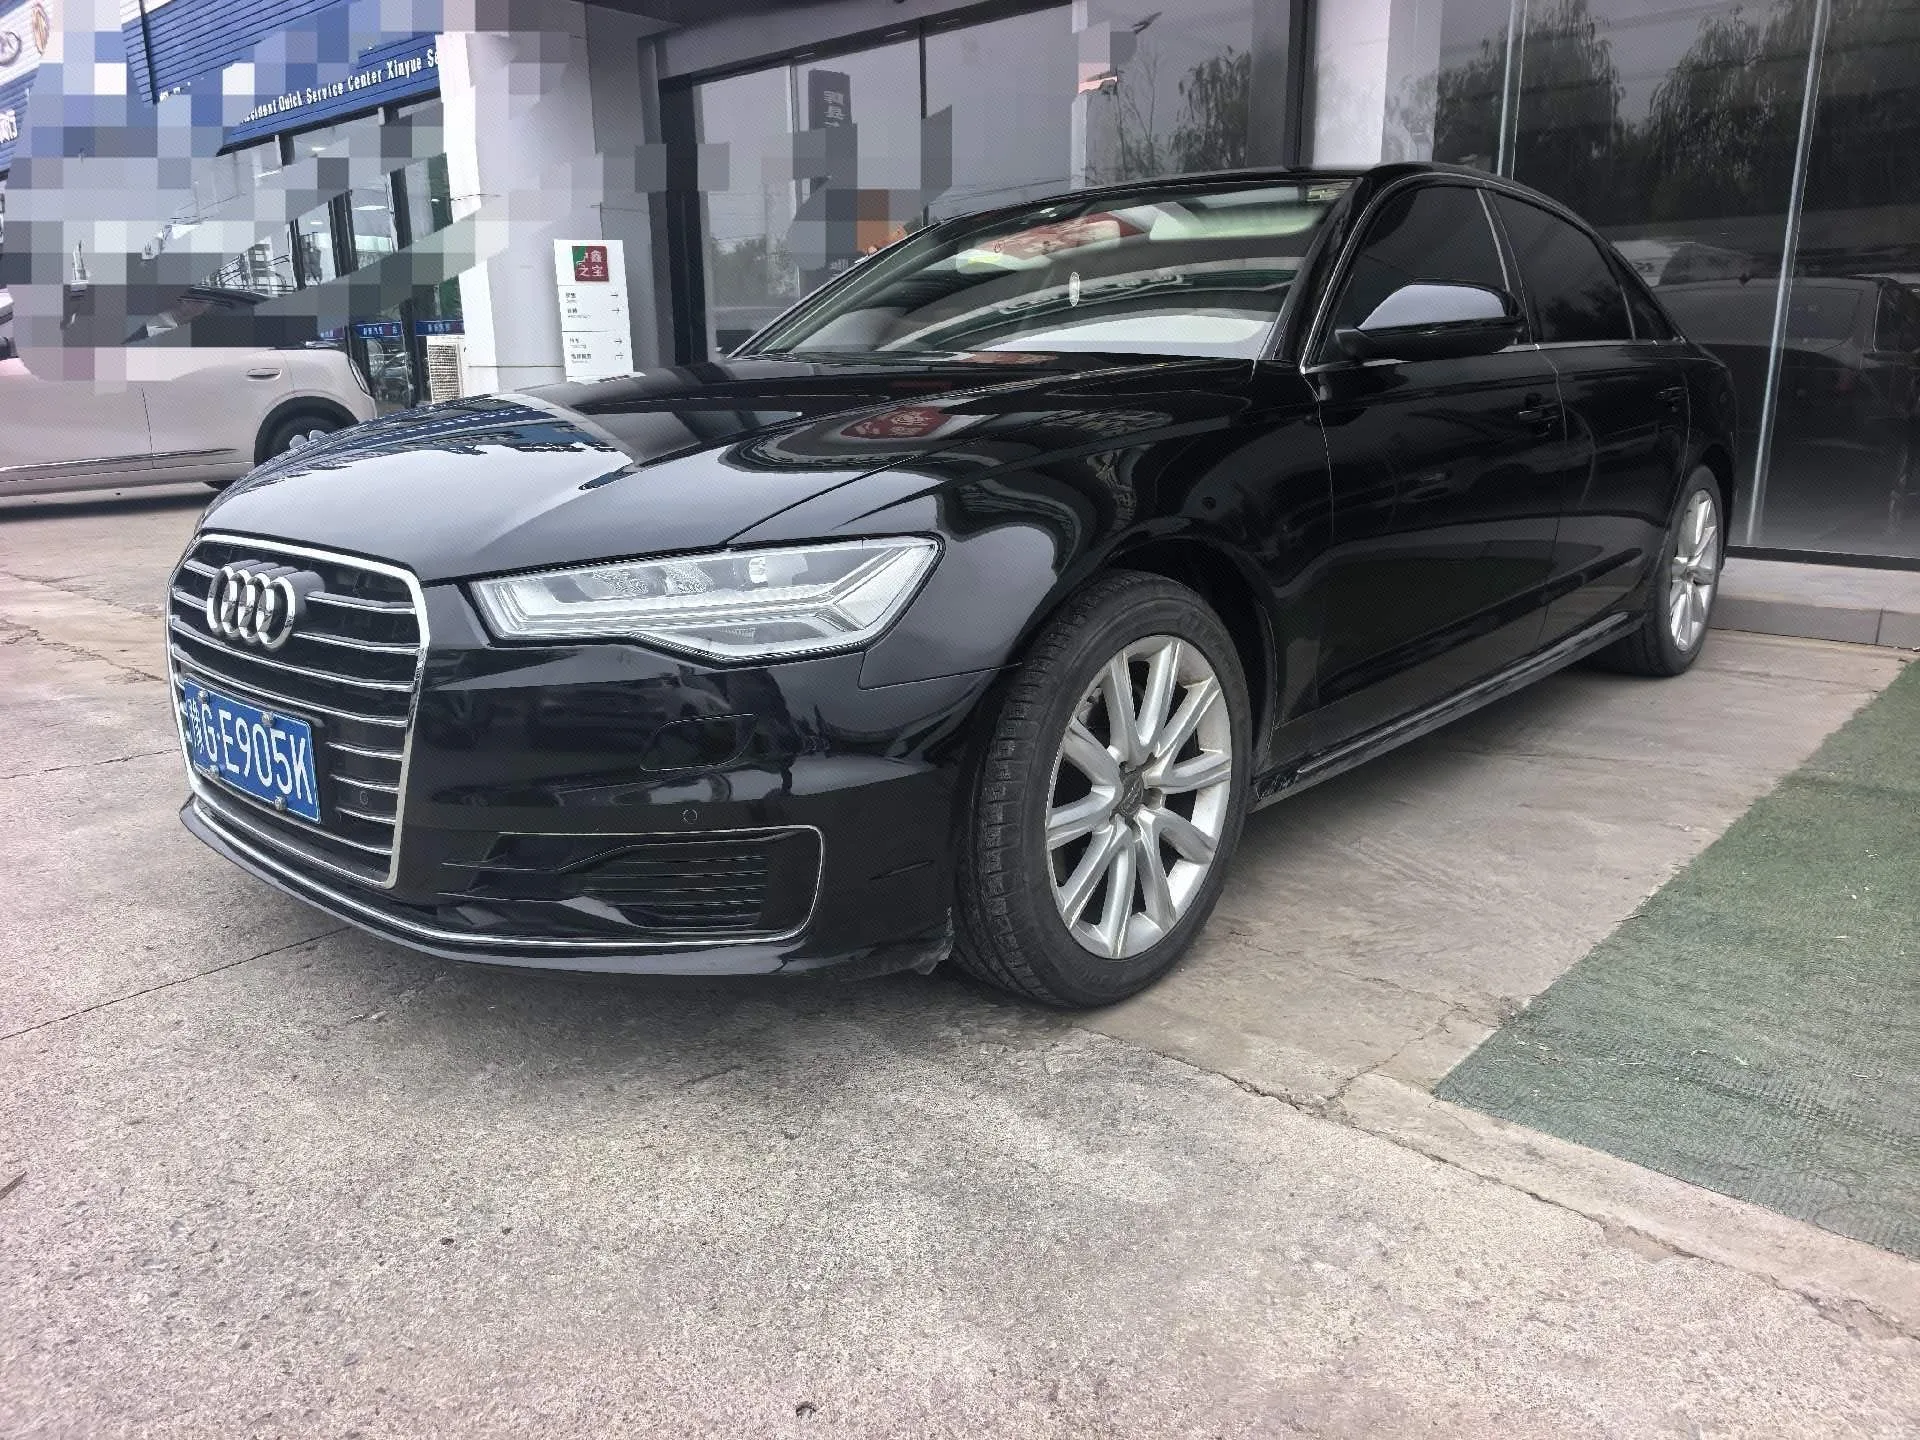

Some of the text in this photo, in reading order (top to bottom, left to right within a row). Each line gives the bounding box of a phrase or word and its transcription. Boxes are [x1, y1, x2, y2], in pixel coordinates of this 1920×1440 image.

[279, 91, 302, 112] Quick
[306, 82, 344, 104] Service
[347, 68, 383, 92] Center
[386, 55, 422, 80] Xinyue
